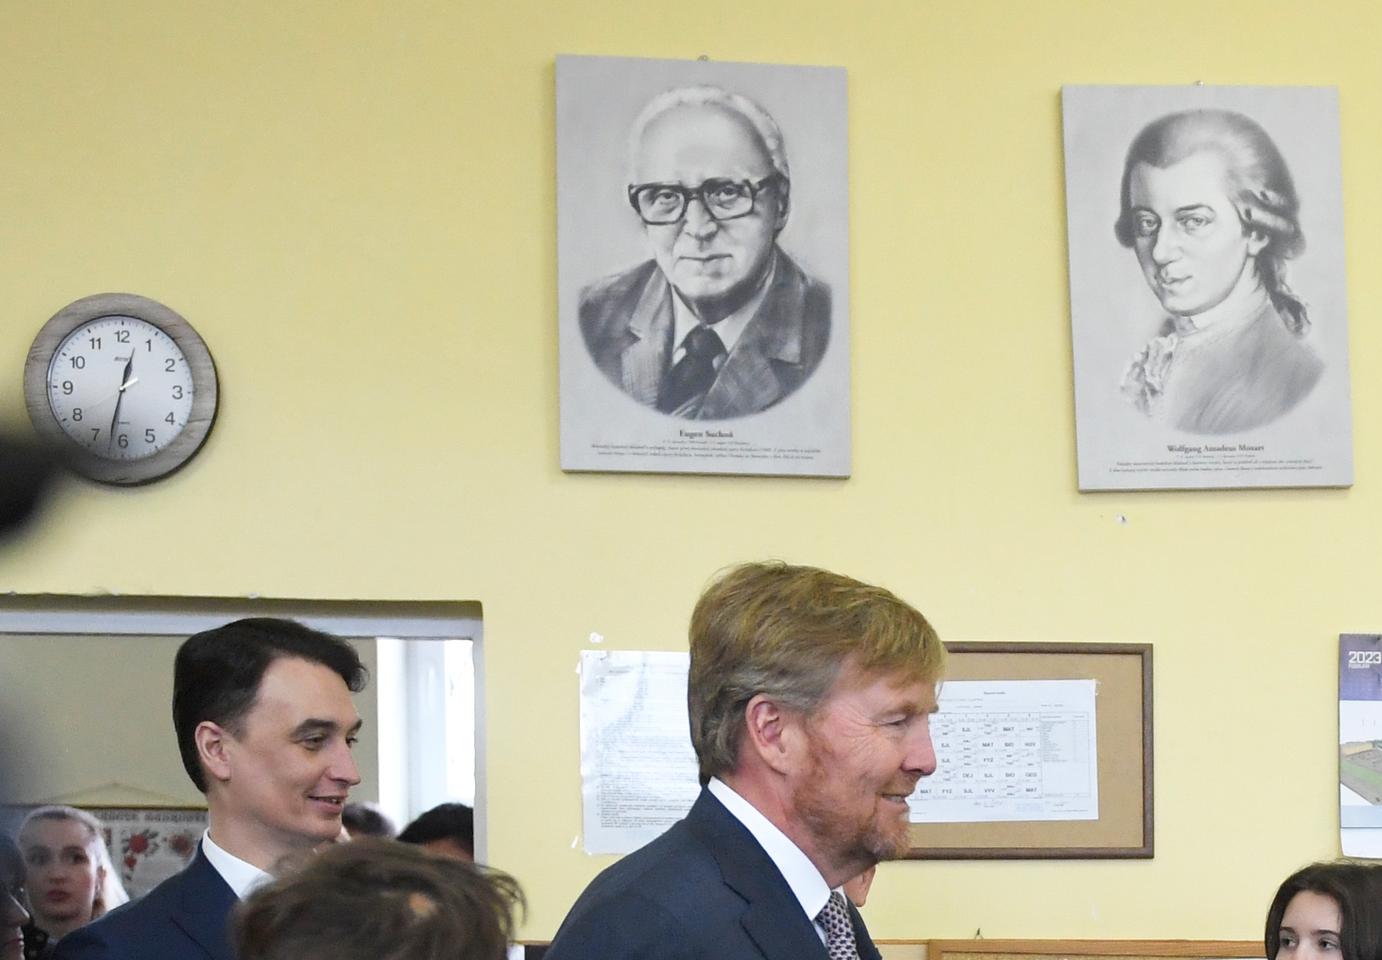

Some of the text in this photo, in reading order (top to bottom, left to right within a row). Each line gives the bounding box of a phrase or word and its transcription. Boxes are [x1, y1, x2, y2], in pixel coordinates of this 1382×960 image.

[114, 330, 131, 344] 12
[89, 338, 101, 350] 11
[146, 339, 151, 352] 1
[70, 356, 86, 369] 10
[165, 359, 175, 372] 2
[62, 381, 74, 395] 9
[172, 385, 183, 400] 3
[72, 408, 82, 422] 8
[165, 412, 175, 425] 4
[91, 428, 100, 441] 7
[118, 434, 128, 448] 6
[144, 429, 156, 444] 5
[1167, 444, 1202, 454] Wolfgang
[1348, 651, 1381, 664] 2023
